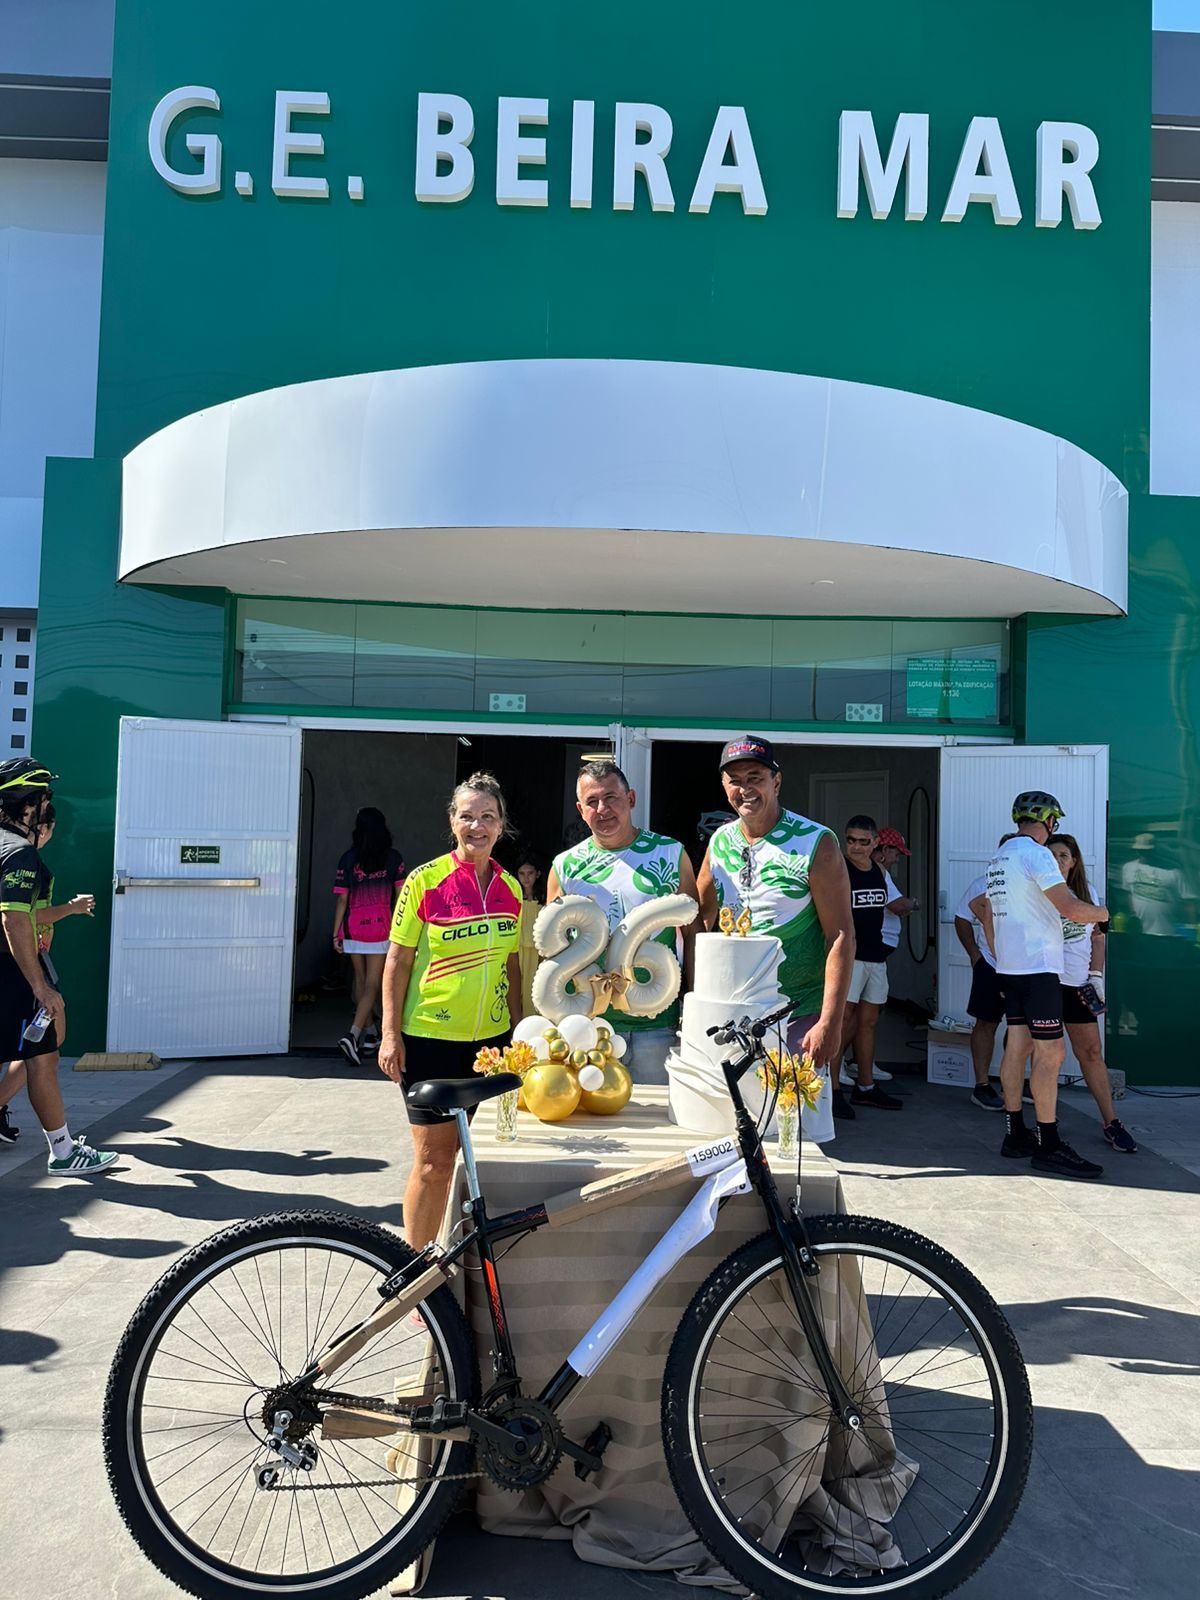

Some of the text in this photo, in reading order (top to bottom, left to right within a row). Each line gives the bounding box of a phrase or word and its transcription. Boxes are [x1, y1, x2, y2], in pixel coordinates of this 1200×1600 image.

[148, 85, 1103, 230] G.E. BEIRA MAR
[395, 884, 410, 926] CICLO
[442, 920, 517, 941] CICLO BIK
[692, 1141, 734, 1164] 159002
